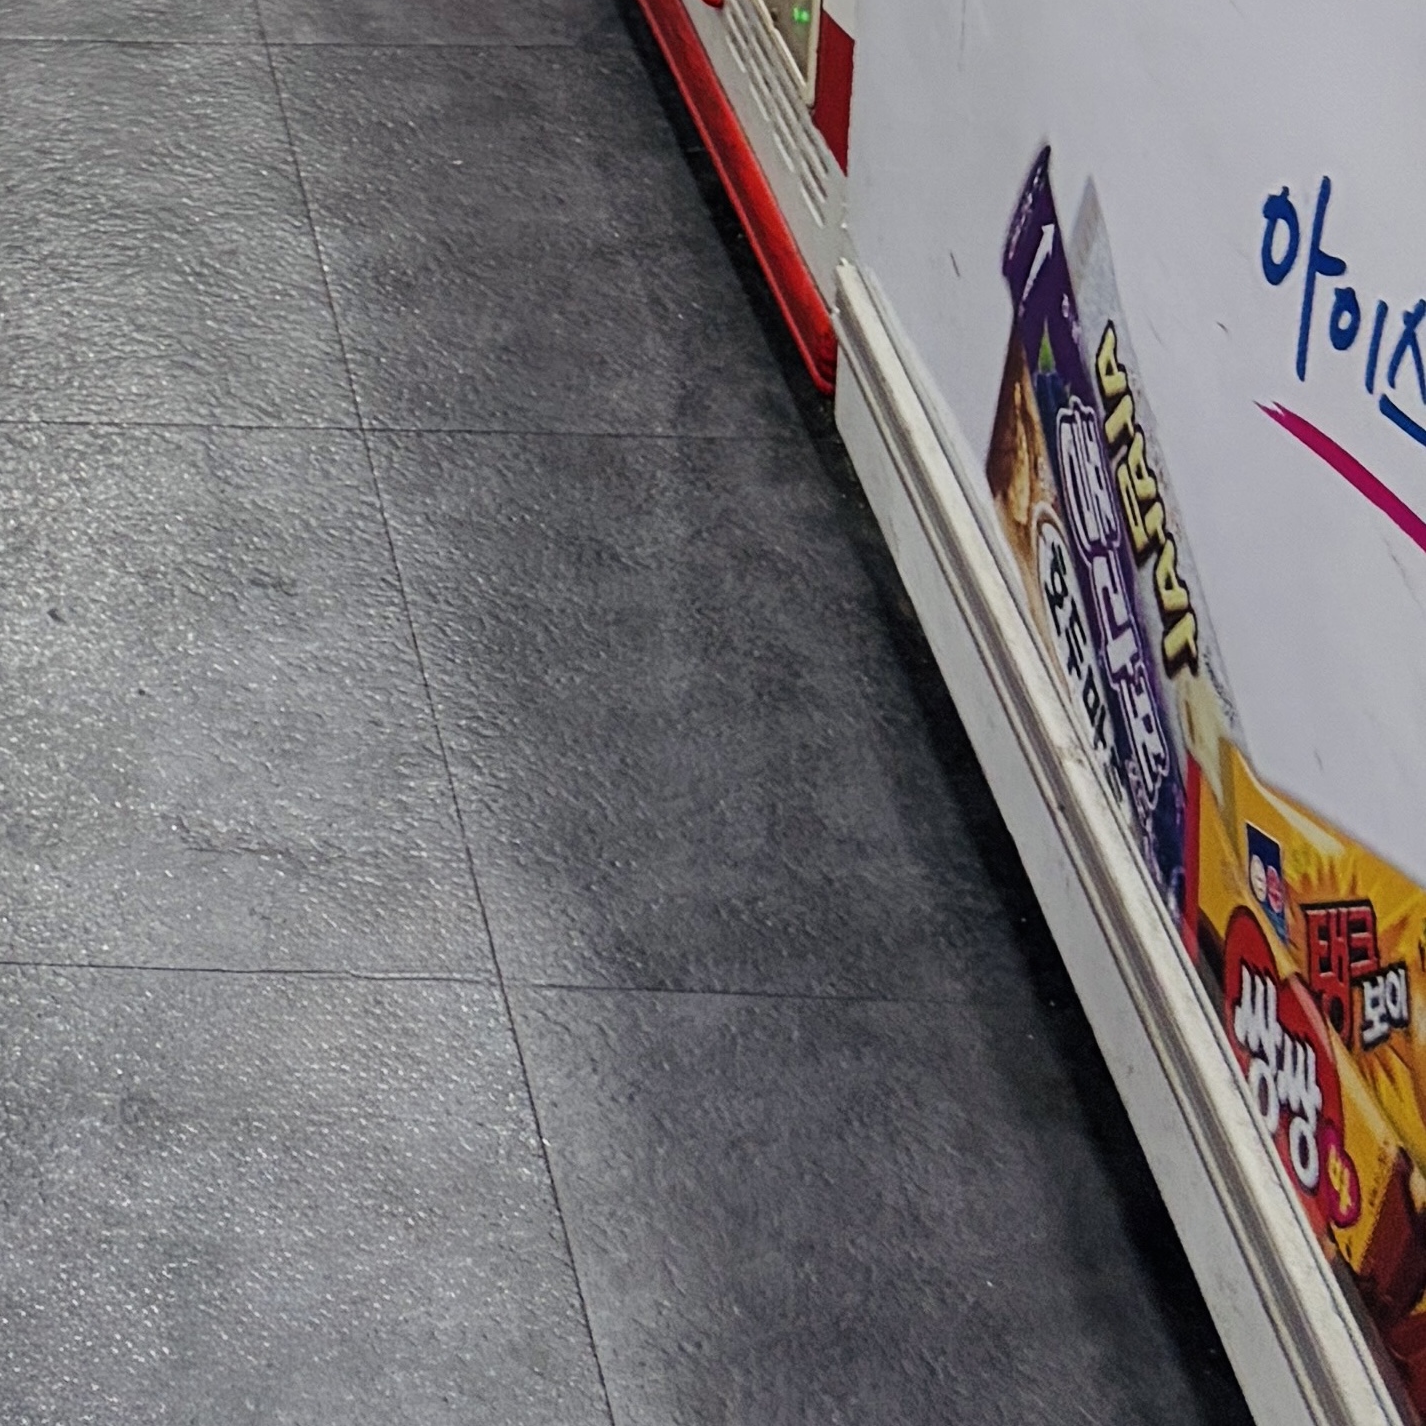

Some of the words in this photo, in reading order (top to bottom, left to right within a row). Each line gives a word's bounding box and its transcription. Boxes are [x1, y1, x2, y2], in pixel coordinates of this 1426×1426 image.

[1304, 900, 1380, 1033] 탱크
[1360, 962, 1408, 1050] 보이
[1234, 970, 1324, 1193] 쌍쌍
